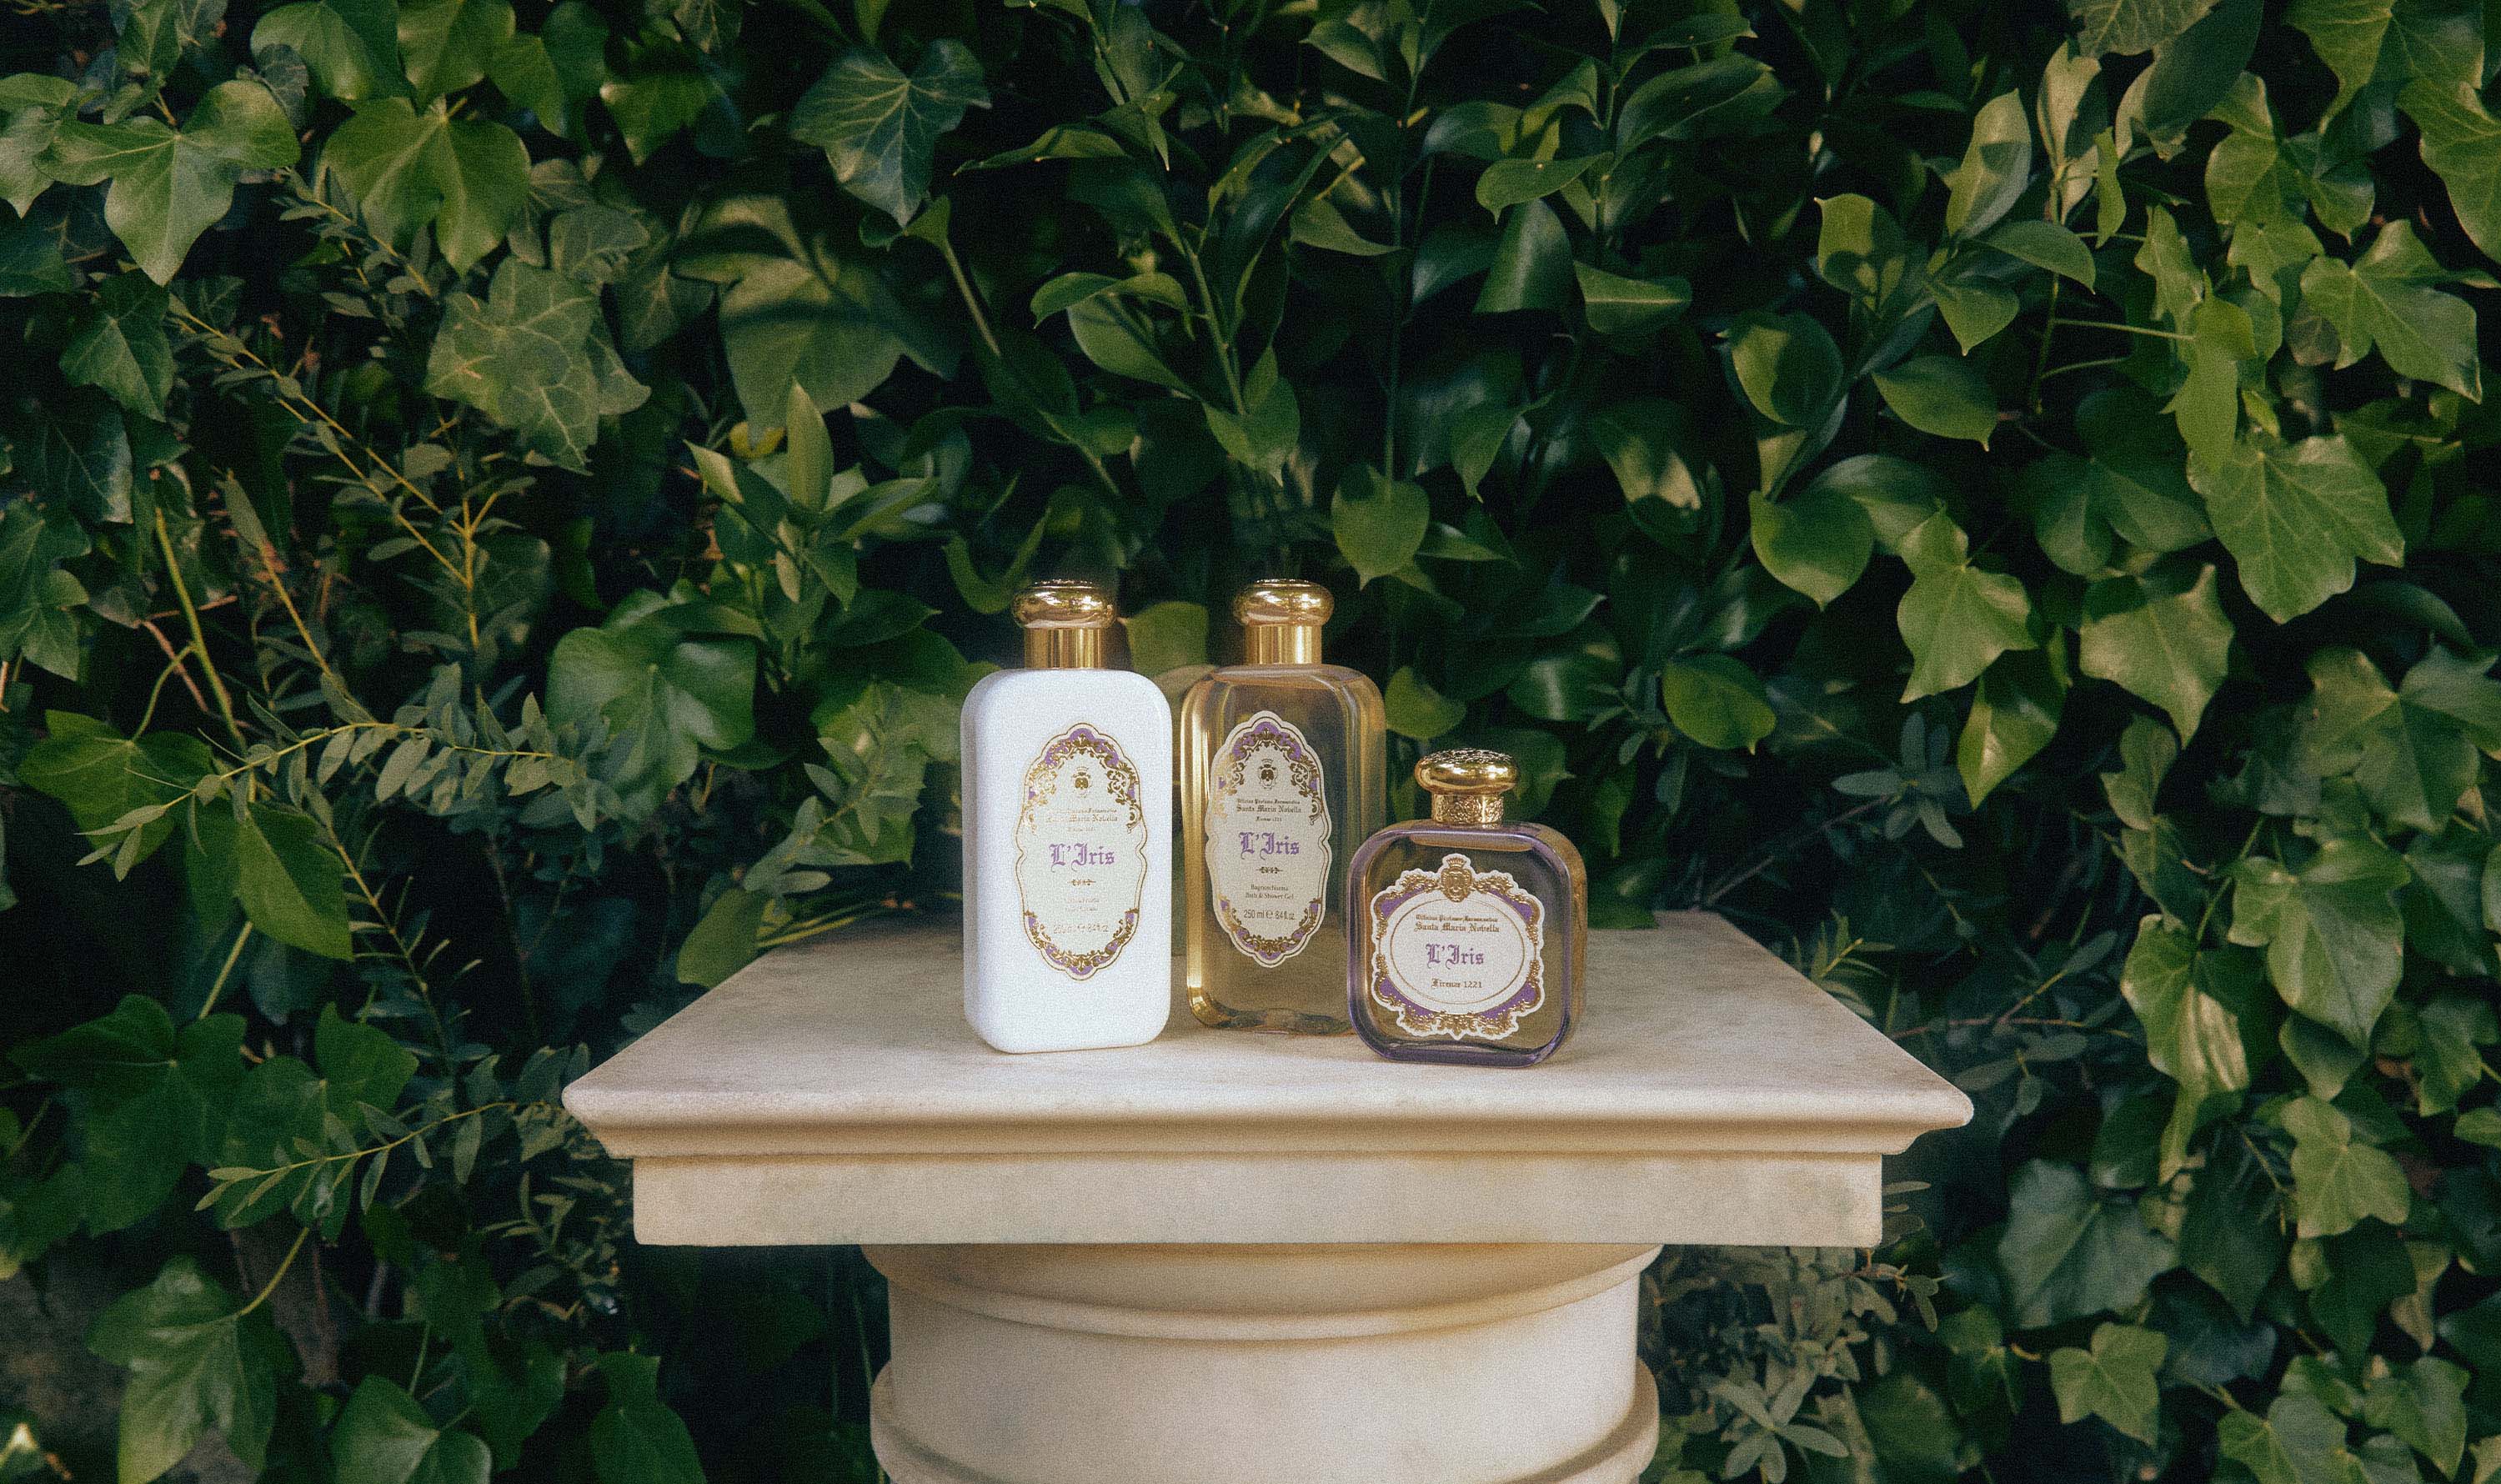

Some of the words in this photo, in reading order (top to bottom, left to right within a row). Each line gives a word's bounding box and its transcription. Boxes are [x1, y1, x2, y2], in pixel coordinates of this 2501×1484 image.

[1049, 843, 1115, 873] L'Iris
[1239, 831, 1300, 860] L'Iris
[1243, 909, 1256, 919] 250
[1414, 921, 1438, 931] Santa
[1441, 922, 1466, 932] Maria
[1468, 923, 1499, 933] Novella
[1426, 944, 1484, 970] L'Iris
